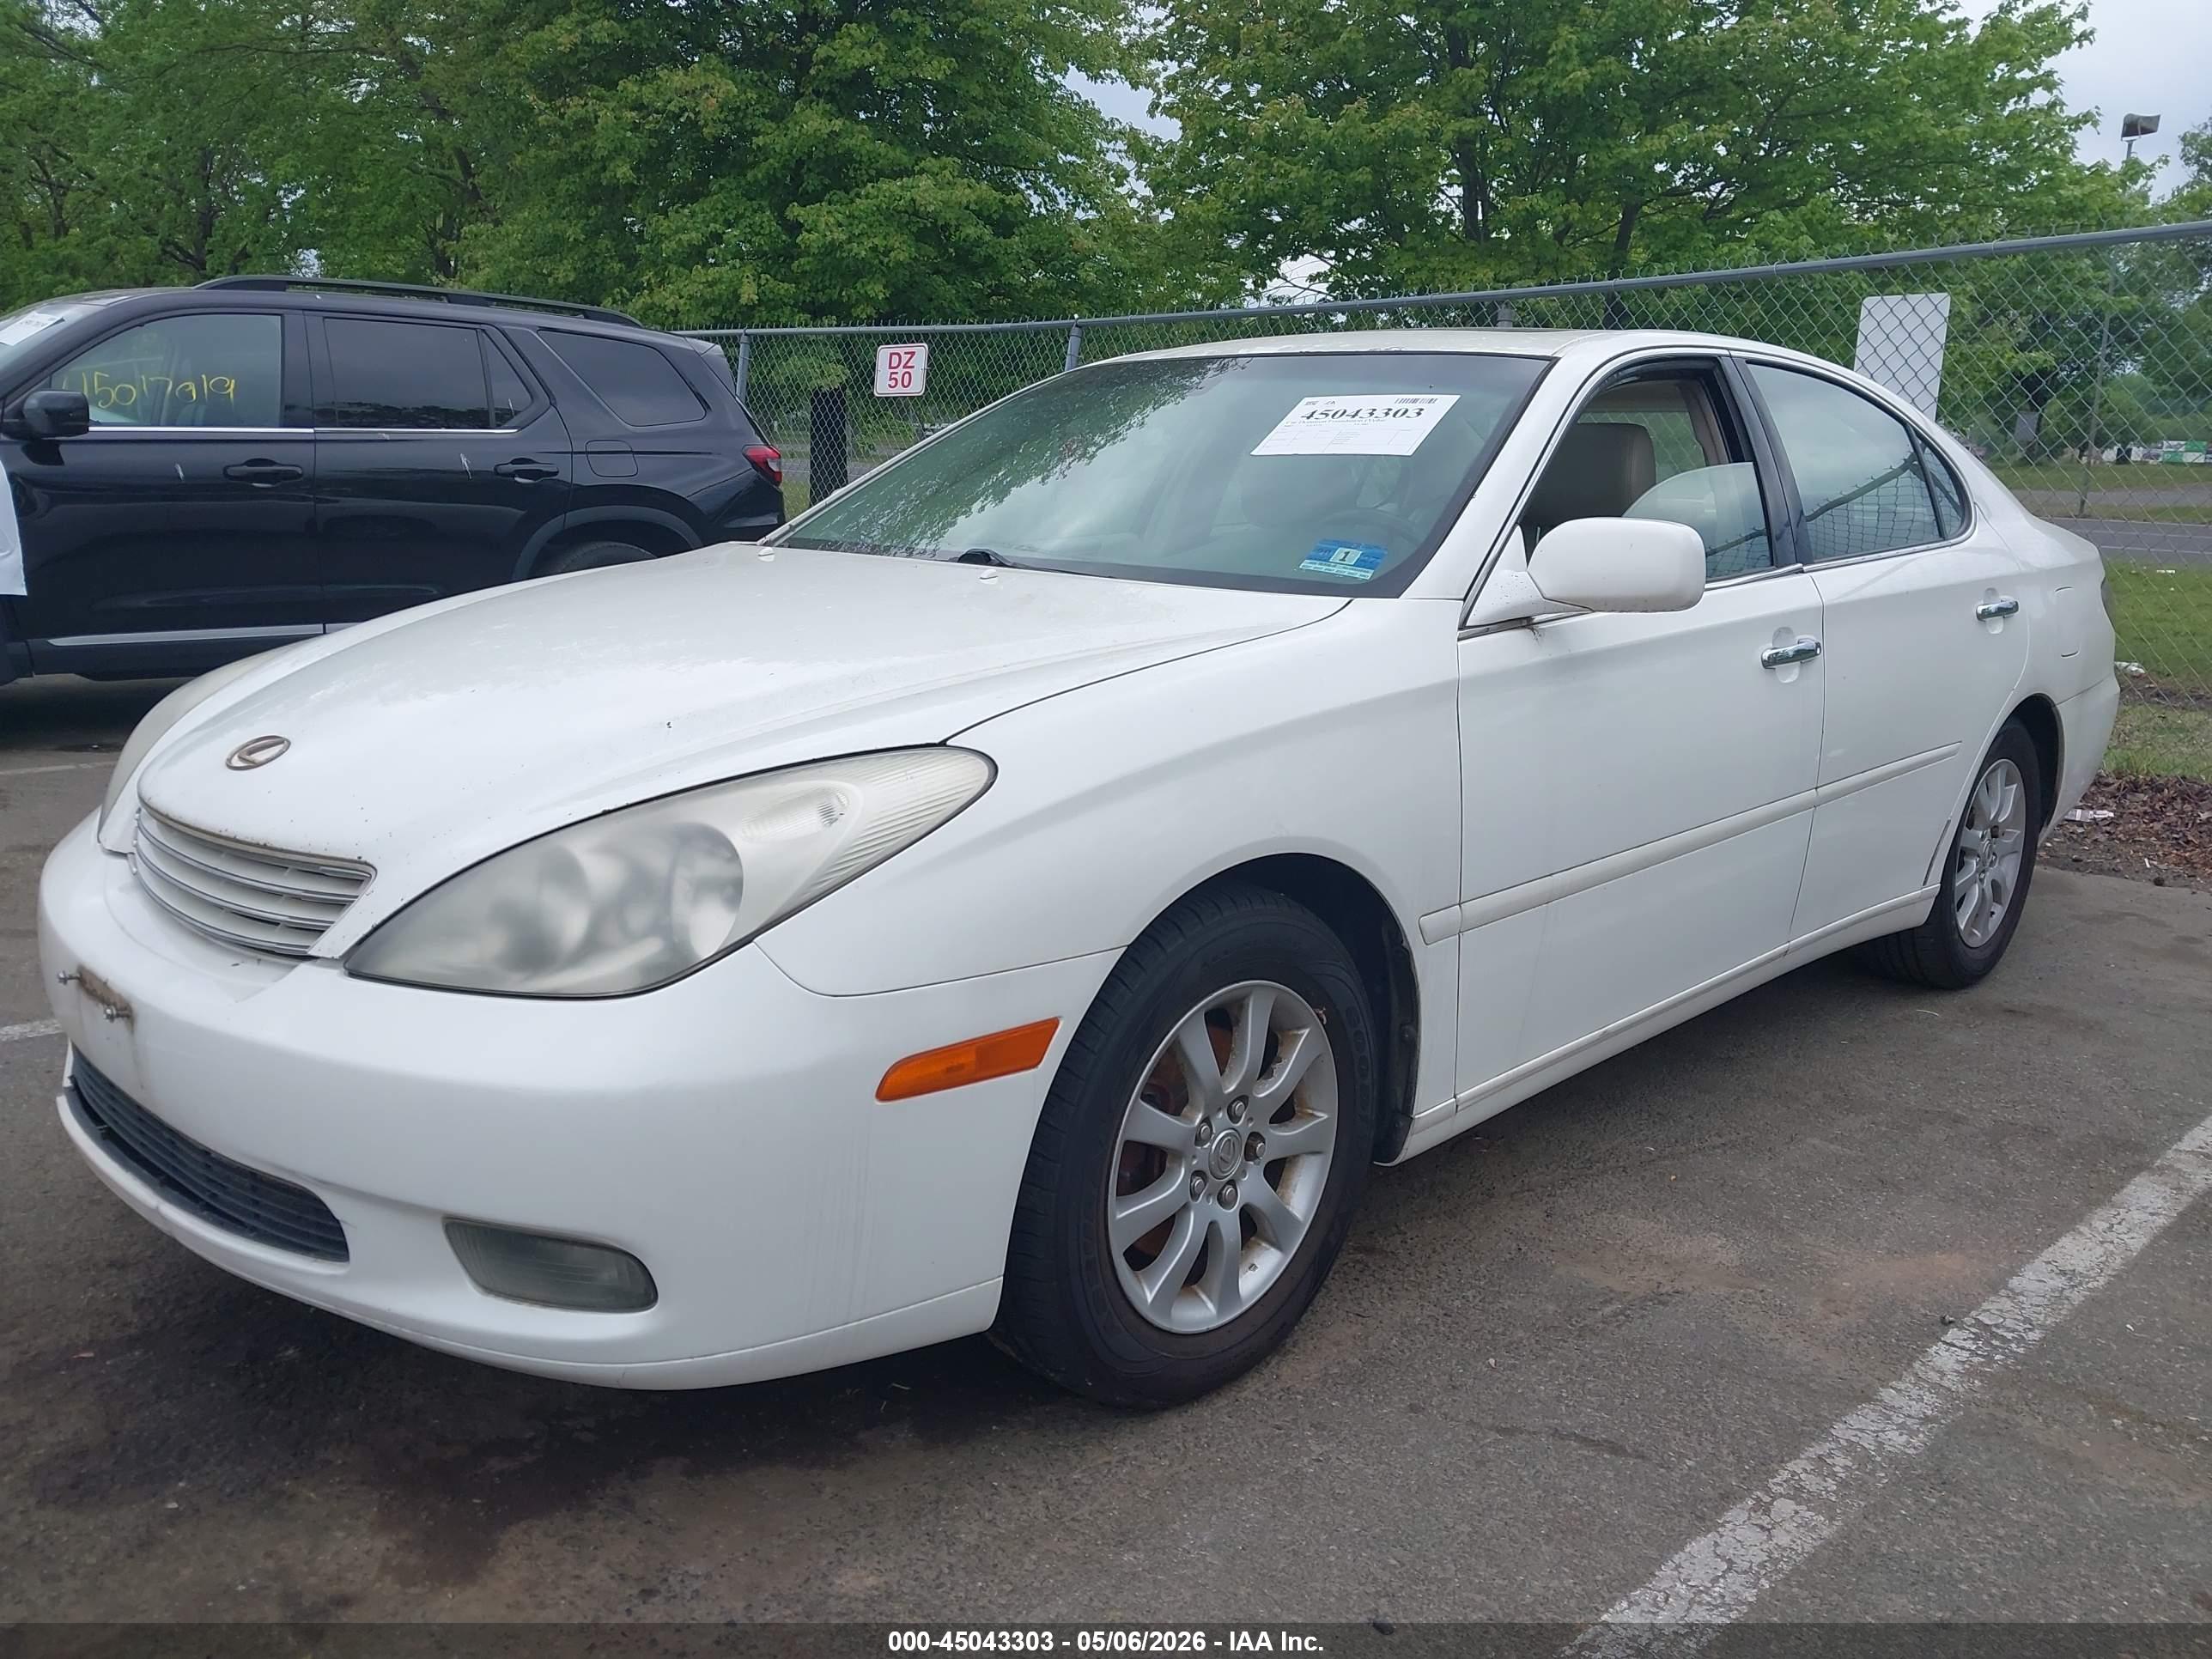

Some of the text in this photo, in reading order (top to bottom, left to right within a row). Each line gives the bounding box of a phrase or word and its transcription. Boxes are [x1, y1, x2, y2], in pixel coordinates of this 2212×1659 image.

[888, 350, 916, 370] DZ
[887, 370, 913, 389] 50
[1300, 407, 1425, 421] 45043303
[1338, 550, 1351, 562] 1
